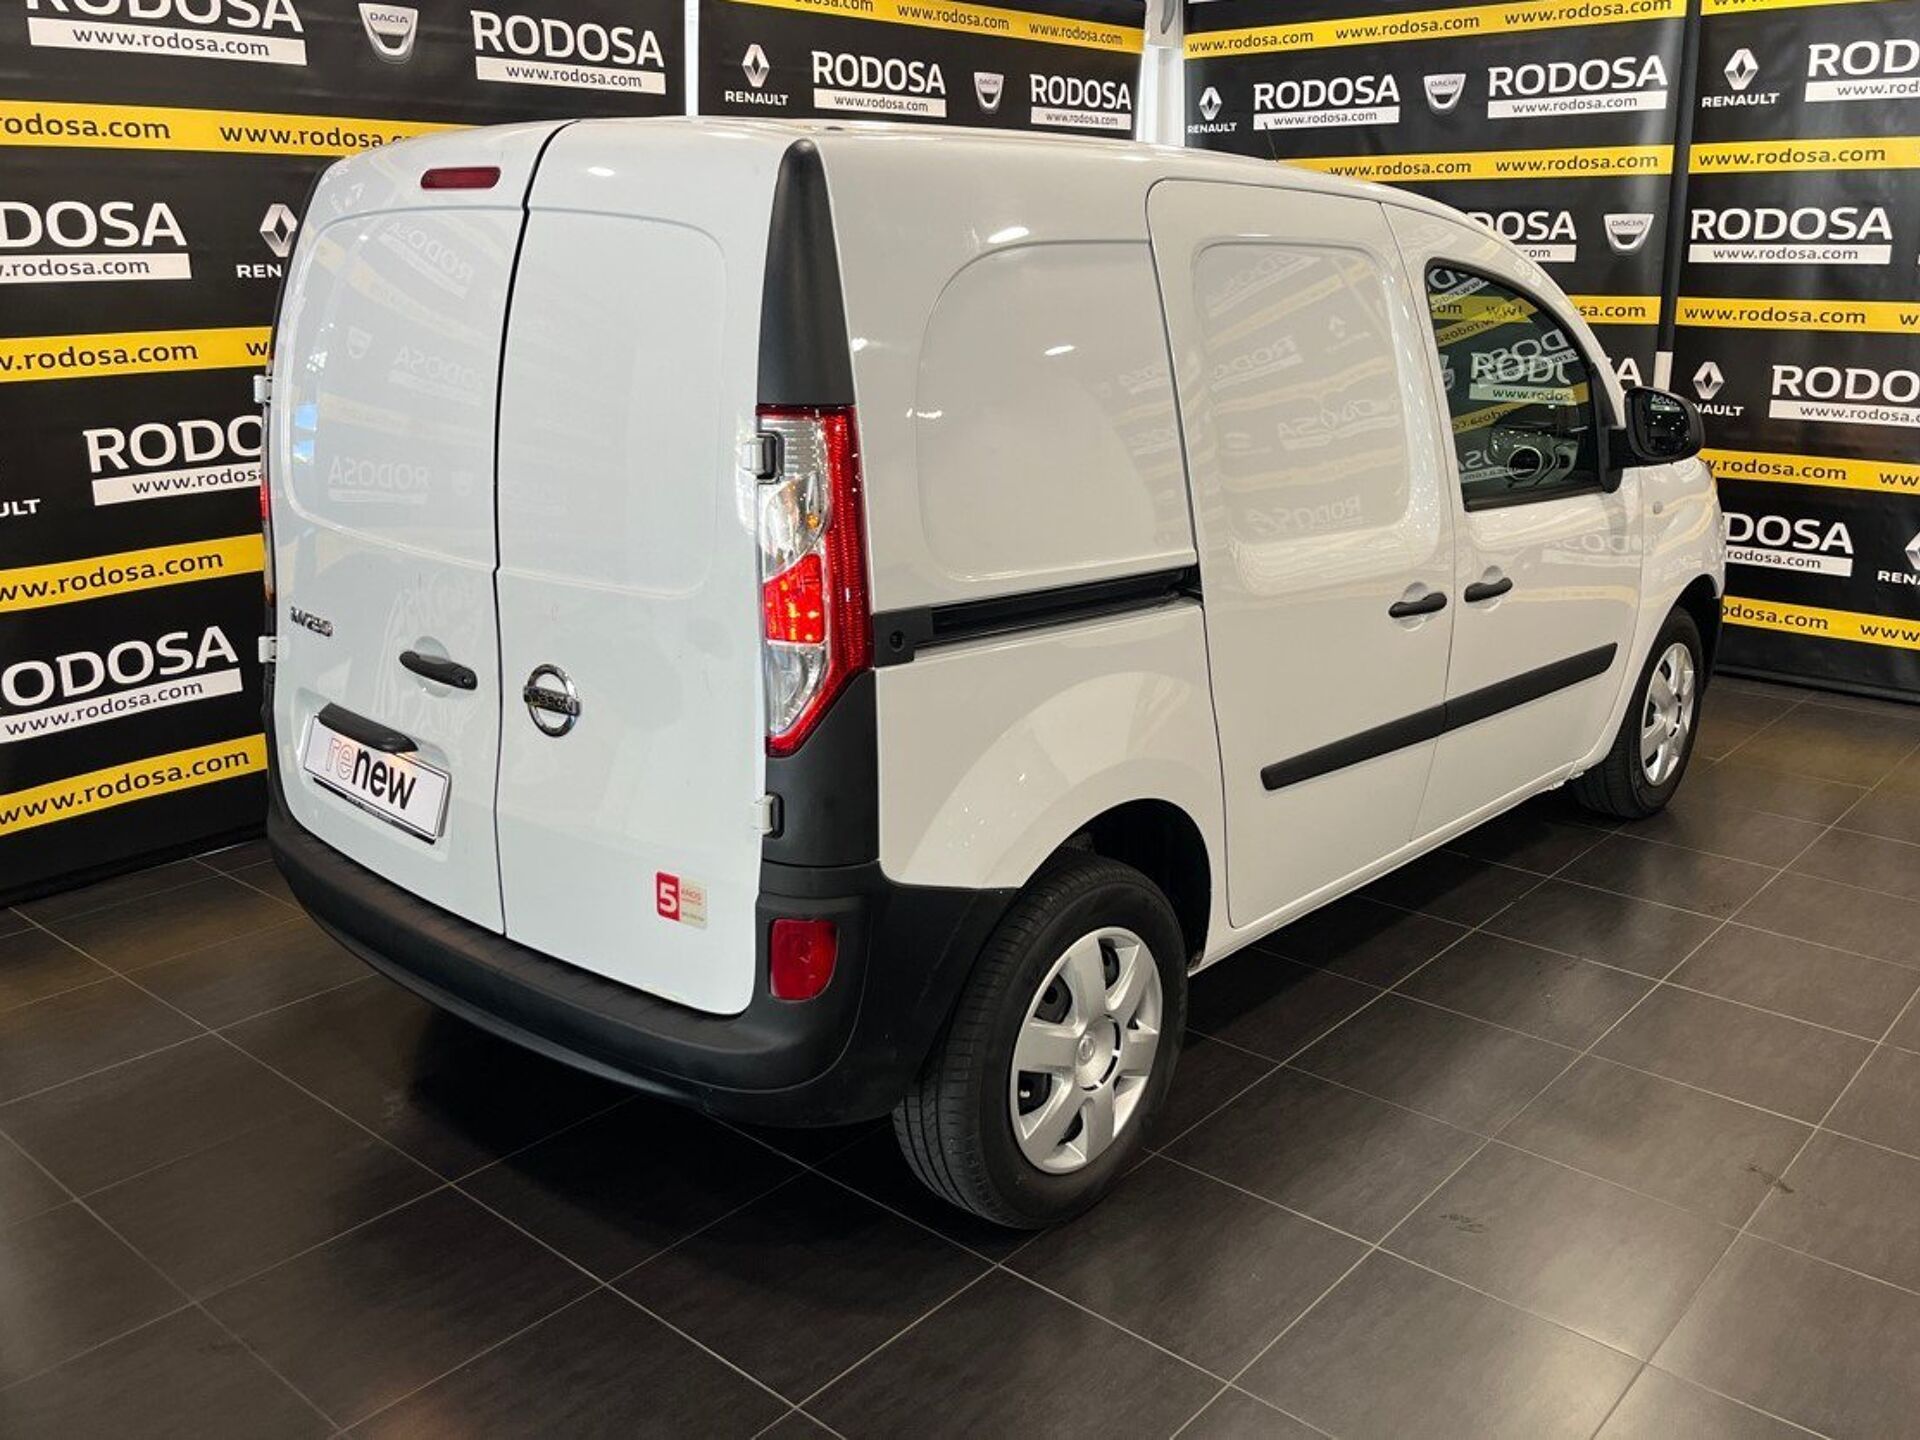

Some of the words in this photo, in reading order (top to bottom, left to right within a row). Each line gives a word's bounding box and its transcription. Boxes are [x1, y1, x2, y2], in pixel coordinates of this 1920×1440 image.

[369, 11, 408, 25] DACIA
[897, 4, 1010, 30] www.rodosa.com
[1505, 0, 1672, 25] www.rodosa.com
[470, 10, 665, 68] RODOSA
[1029, 22, 1123, 46] www.rodosa.com
[1336, 15, 1479, 40] www.rodosa.com
[72, 28, 270, 56] www.rodosa.com
[1189, 31, 1314, 52] www.rodosa.com
[1808, 39, 1919, 77] ROD
[506, 65, 642, 87] www.rodosa.com
[811, 51, 946, 95] RODOSA
[1488, 55, 1668, 97] RODOSA
[725, 91, 788, 106] RENAULT
[1030, 74, 1132, 110] RODOSA
[1253, 74, 1400, 110] RODOSA
[1701, 92, 1780, 108] RENAULT
[1837, 80, 1919, 96] www.rod
[834, 95, 929, 112] www.rodosa.com
[1512, 94, 1638, 113] www.rodosa.com
[1046, 112, 1118, 126] www.rodosa.com
[1188, 122, 1237, 133] RENAULT
[1274, 110, 1377, 126] www.rodosa.com
[1496, 155, 1658, 172] www.rodosa.com
[1699, 148, 1886, 166] www.rodosa.com
[0, 201, 187, 248] DOSA
[1691, 207, 1893, 241] RODOSA
[1713, 246, 1858, 260] www.rodosa.com
[0, 259, 150, 277] .rodosa.com
[236, 264, 282, 278] REN
[1684, 307, 1866, 324] www.rodosa.com
[1772, 364, 1920, 403] RODO
[83, 415, 262, 473] RODO
[1723, 512, 1854, 555] DOSA
[1727, 548, 1821, 569] rodosa.com
[0, 552, 223, 600] ww.rodosa.com
[1, 625, 238, 707] ODOSA
[5, 682, 203, 735] www.rodosa.com
[326, 737, 416, 810] renew
[0, 750, 250, 825] www.rodosa.com
[660, 881, 678, 913] 5
